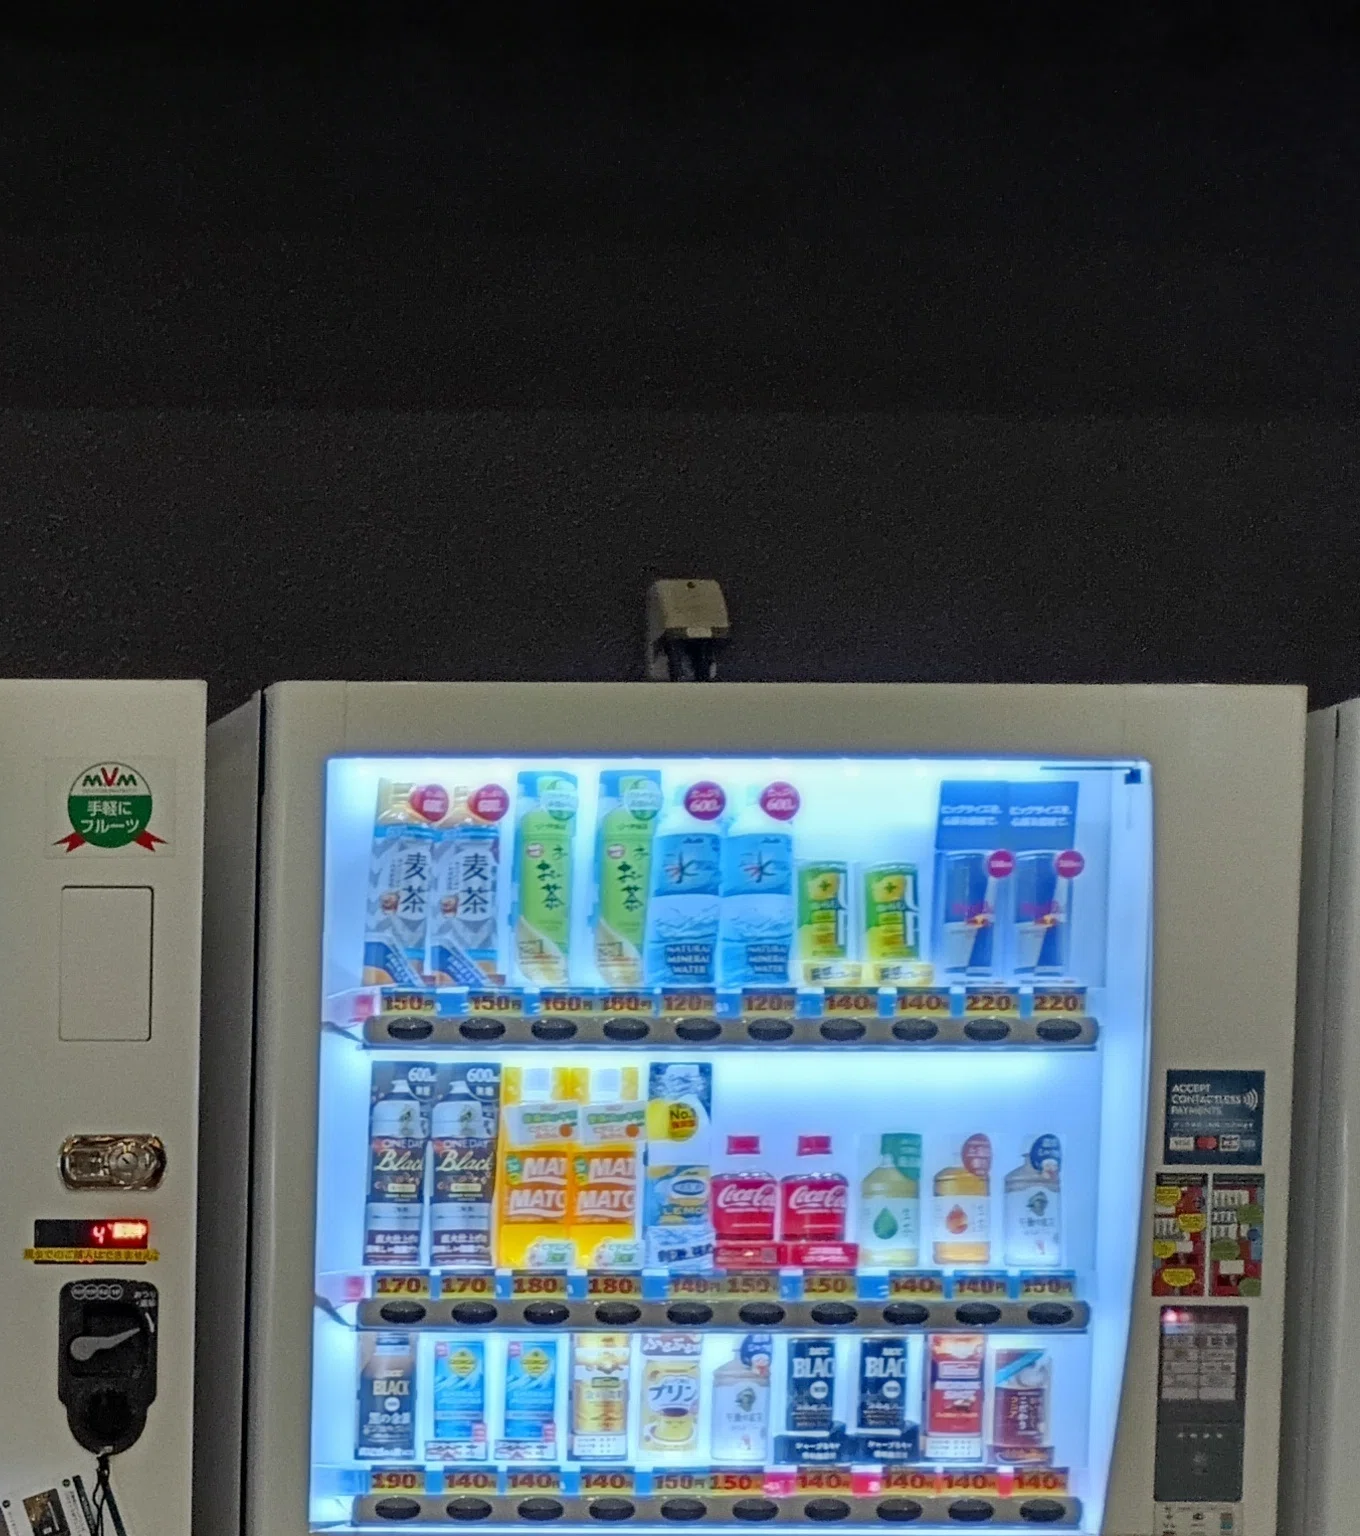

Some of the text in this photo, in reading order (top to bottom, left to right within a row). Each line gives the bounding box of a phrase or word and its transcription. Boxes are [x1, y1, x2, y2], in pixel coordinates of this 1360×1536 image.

[87, 800, 133, 817] 手軽に
[80, 819, 140, 834] フルーツ
[400, 853, 428, 914] 麦茶
[459, 853, 487, 914] 麦茶
[1171, 1083, 1211, 1093] ACCEPT
[1171, 1094, 1242, 1105] CONTACTLESS
[1170, 1106, 1223, 1116] PAYMENTS
[436, 1151, 492, 1171] Black
[648, 1384, 697, 1402] プリン
